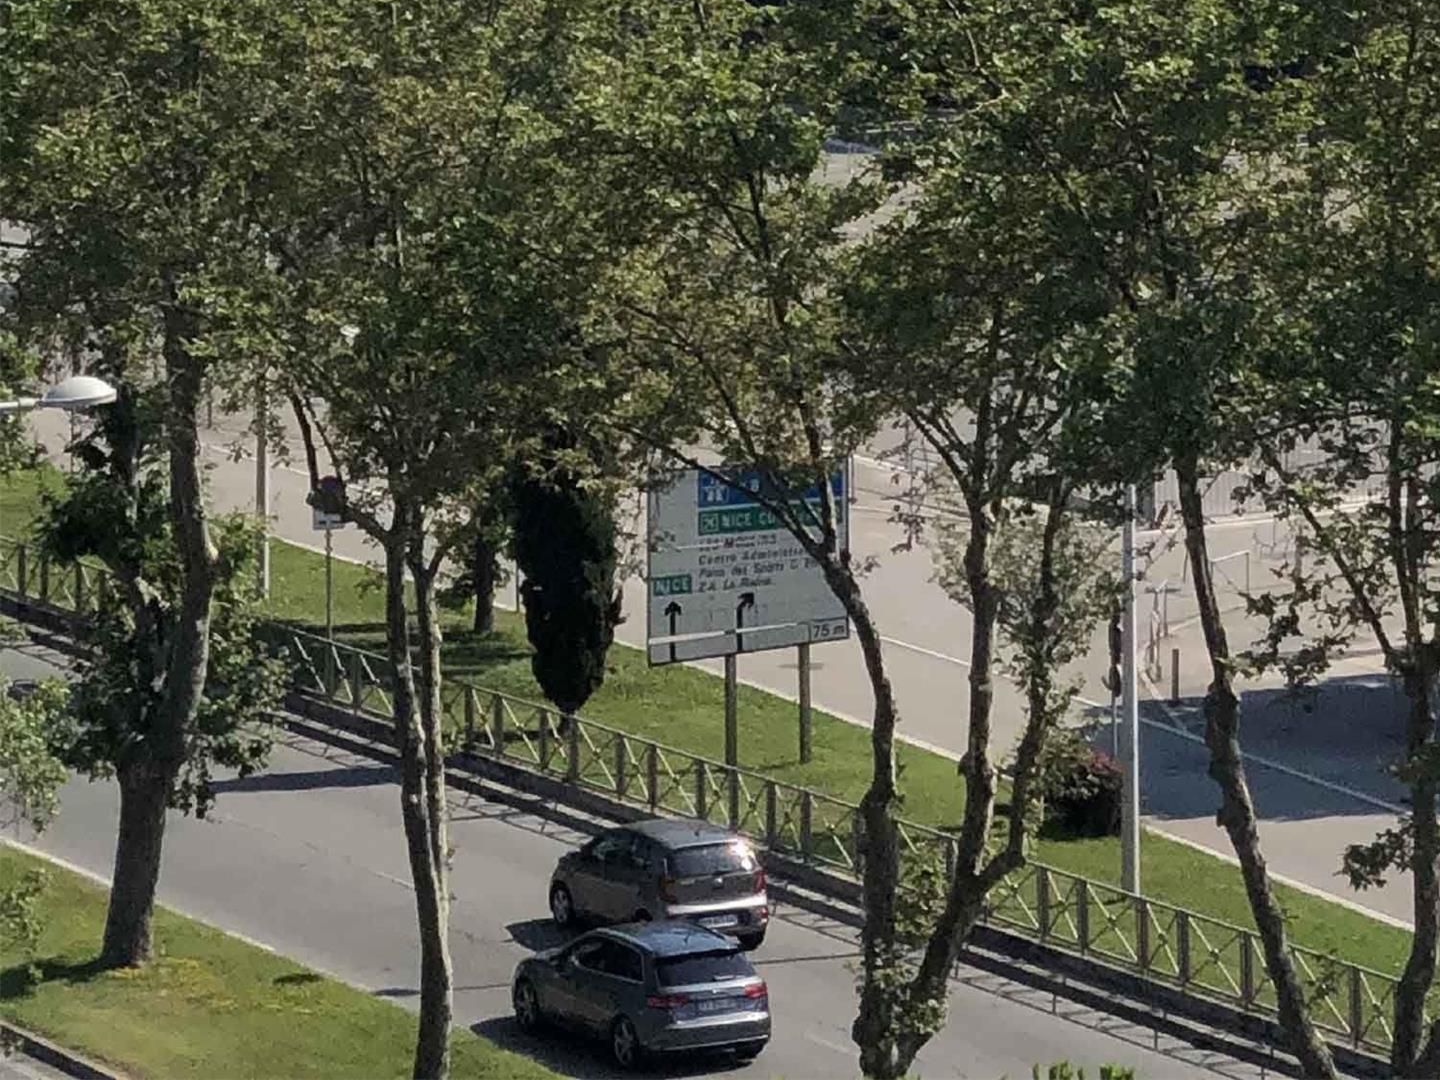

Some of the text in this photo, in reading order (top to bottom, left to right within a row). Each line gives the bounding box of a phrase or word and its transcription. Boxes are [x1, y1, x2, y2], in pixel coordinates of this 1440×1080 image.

[721, 511, 752, 528] NICE
[654, 579, 689, 595] NICE
[813, 624, 845, 638] 75 m
